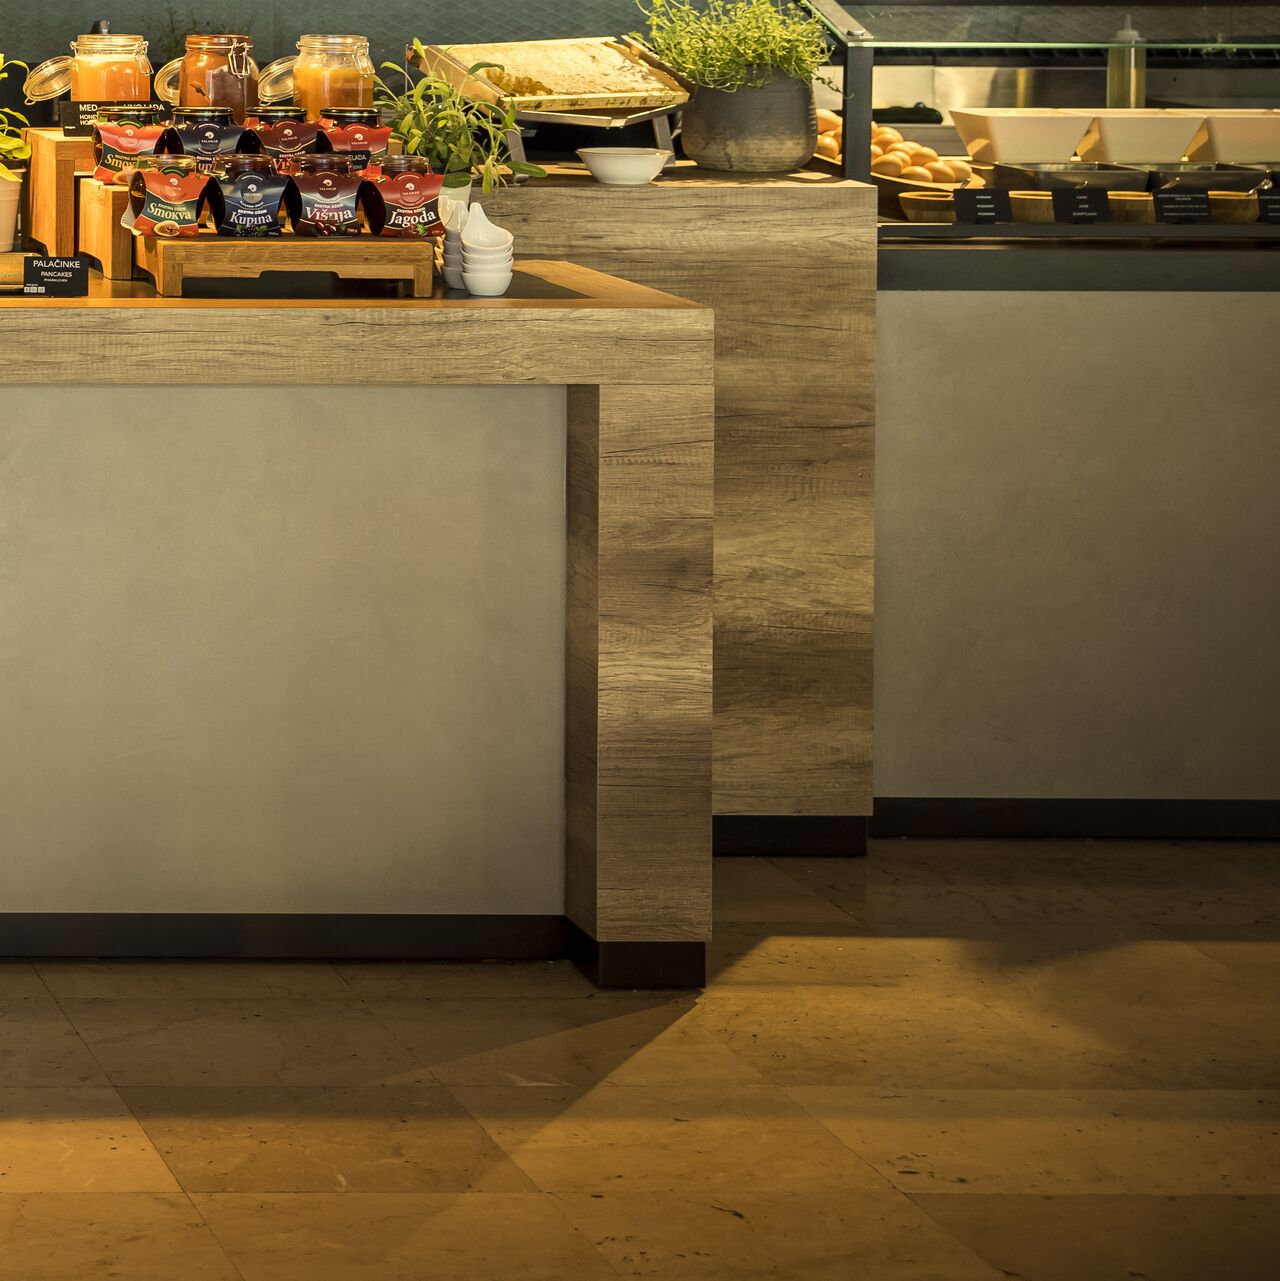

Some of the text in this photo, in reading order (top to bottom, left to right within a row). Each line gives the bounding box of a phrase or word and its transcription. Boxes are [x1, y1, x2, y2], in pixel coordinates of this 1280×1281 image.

[79, 104, 98, 112] MED
[147, 202, 192, 221] Smokva
[229, 211, 273, 228] Kupina
[305, 206, 353, 224] Višnja
[388, 210, 437, 228] Jagoda
[33, 259, 80, 269] PALAČINKE
